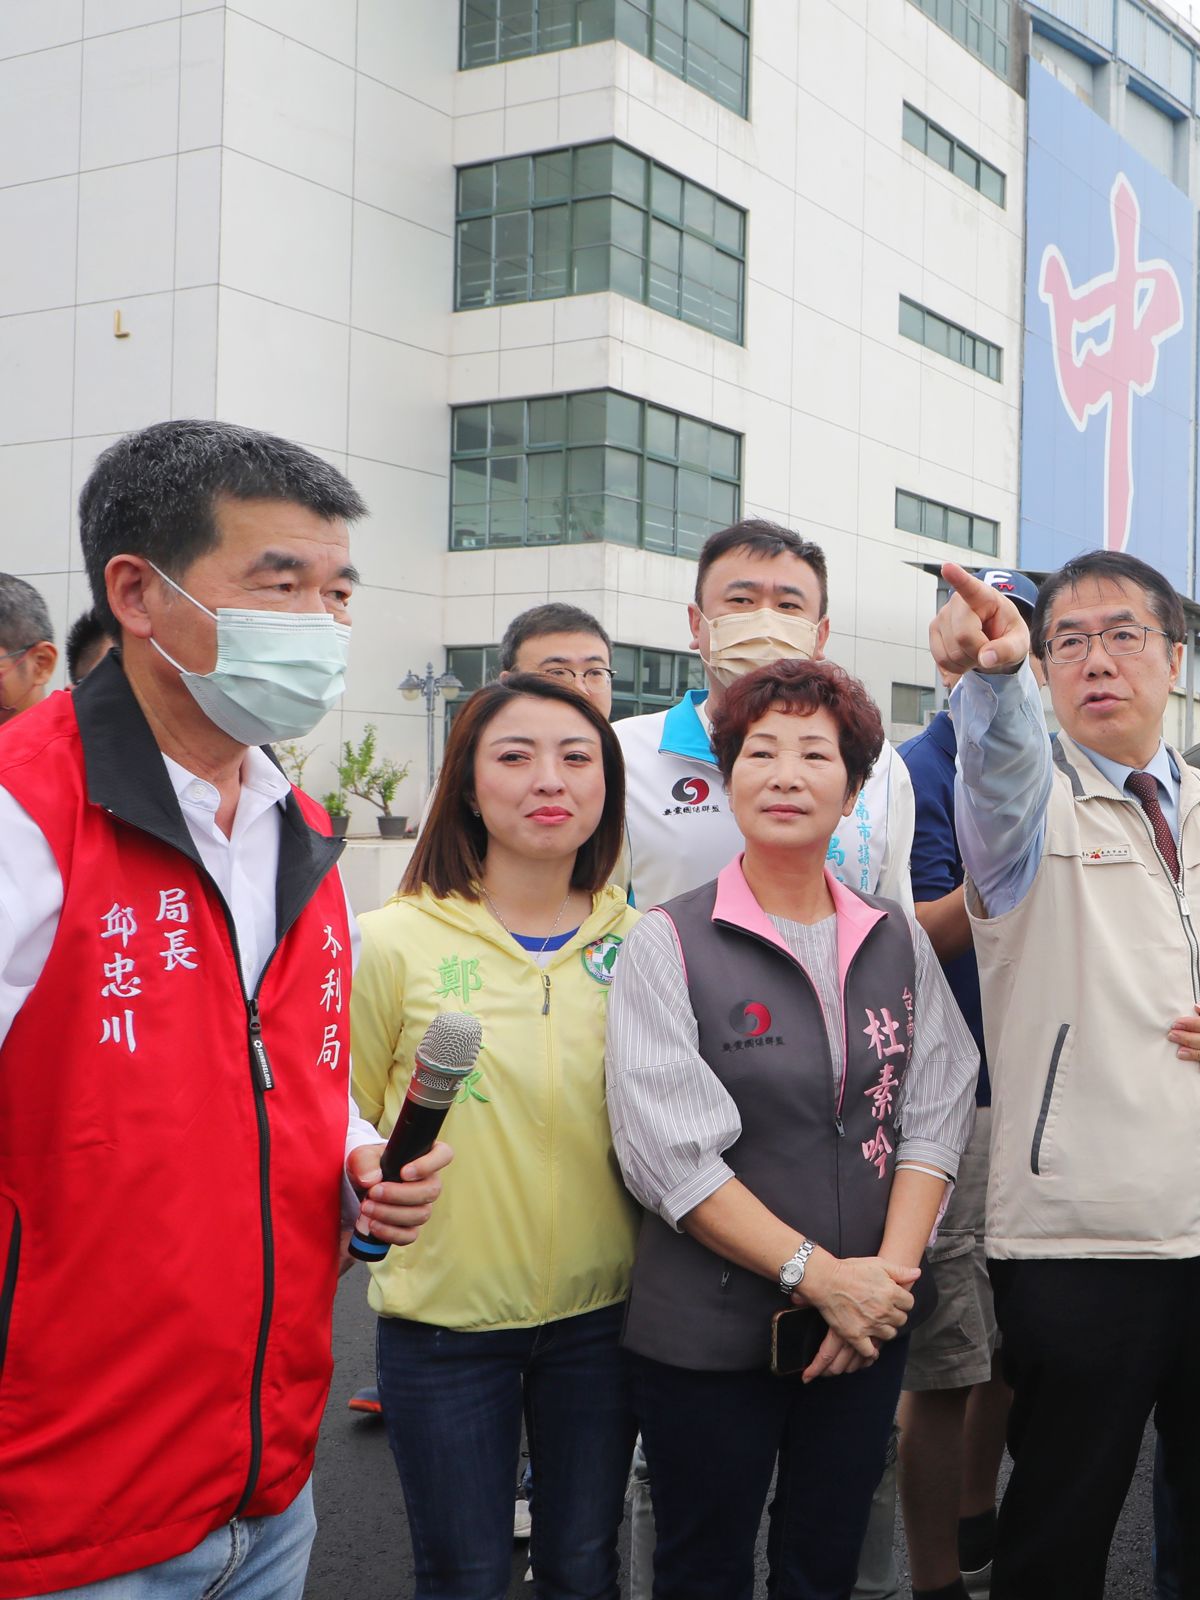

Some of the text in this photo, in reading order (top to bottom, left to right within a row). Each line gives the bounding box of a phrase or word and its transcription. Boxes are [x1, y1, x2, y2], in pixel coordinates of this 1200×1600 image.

[98, 902, 143, 1054] 邱忠川
[155, 887, 199, 972] 局長
[861, 1007, 906, 1180] 杜素吟
